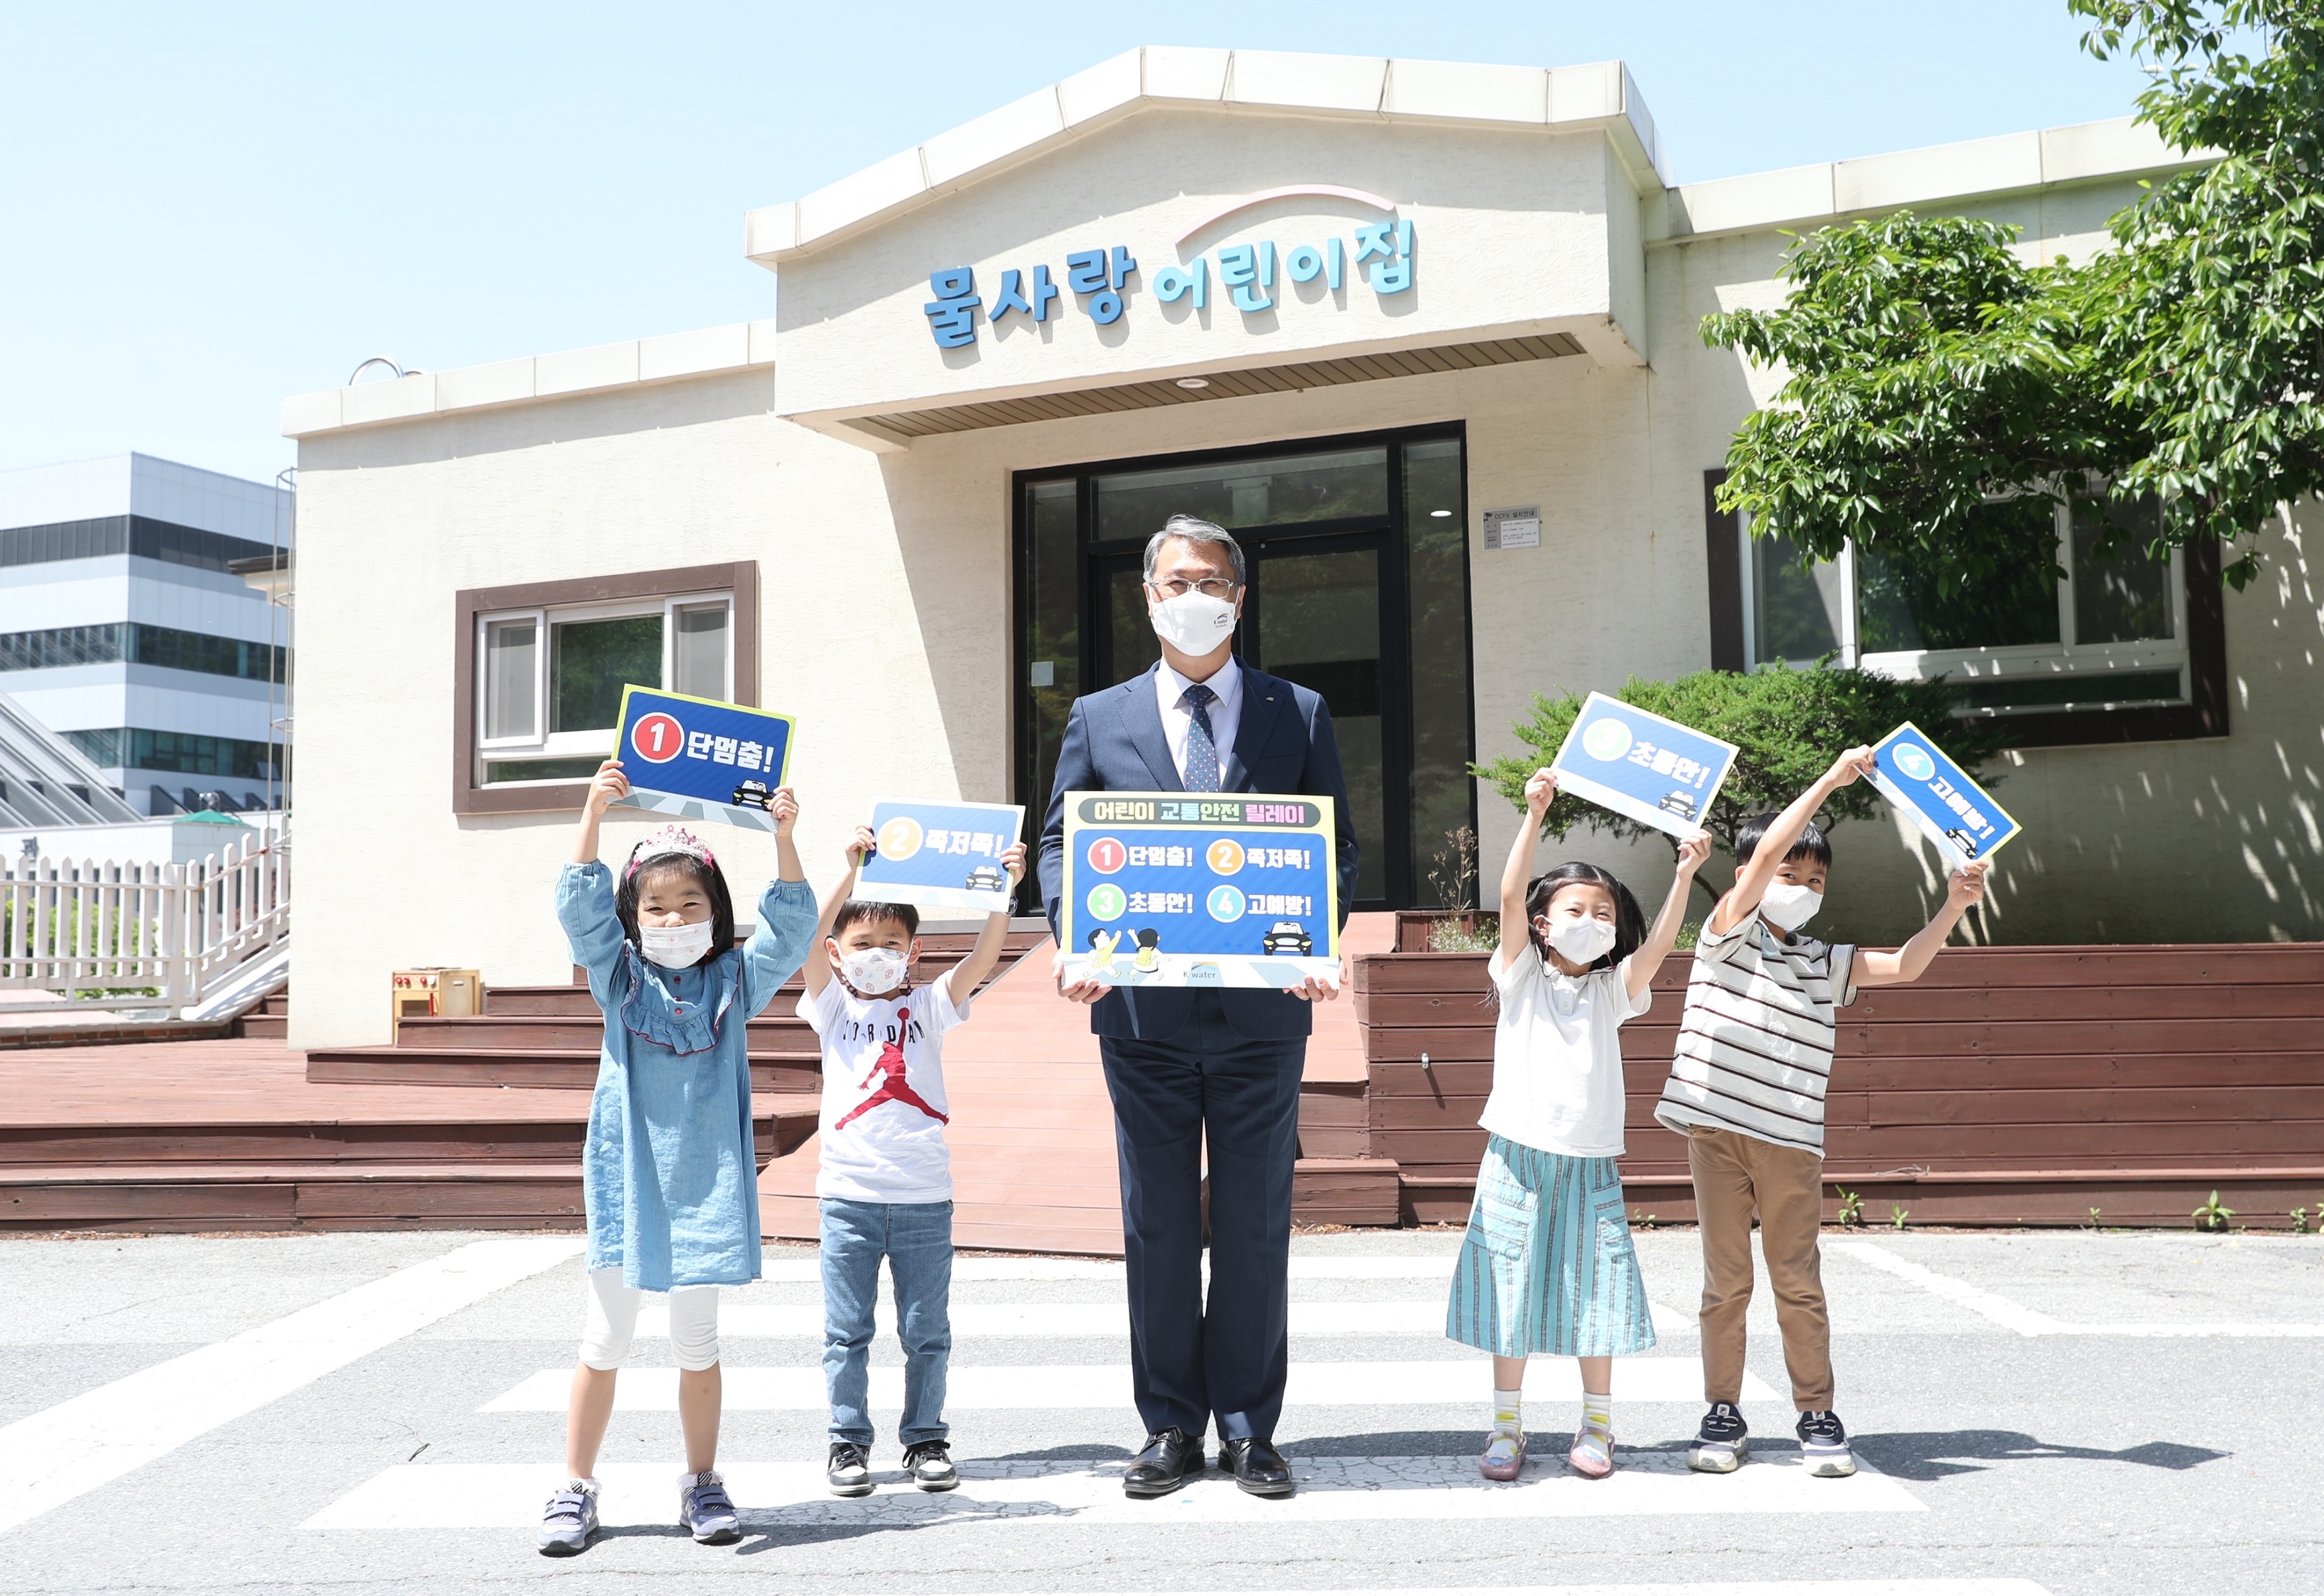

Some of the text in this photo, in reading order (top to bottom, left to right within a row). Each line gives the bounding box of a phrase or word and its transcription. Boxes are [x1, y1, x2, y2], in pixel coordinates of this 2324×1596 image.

[924, 219, 1413, 349] 물사랑 어린이집
[687, 731, 774, 773] 단멈춤!
[1627, 741, 1711, 789] 초동안!
[1094, 802, 1304, 824] 어린이 교통안전 릴레이
[1928, 776, 1995, 840] 고예방!
[925, 828, 1004, 859] 쪽저쪽!
[1128, 845, 1193, 867] 단멈춤!
[1246, 848, 1310, 870] 쪽저쪽!
[1128, 892, 1193, 914] 초동안!
[1247, 894, 1312, 916] 고예방!
[1192, 971, 1217, 979] water
